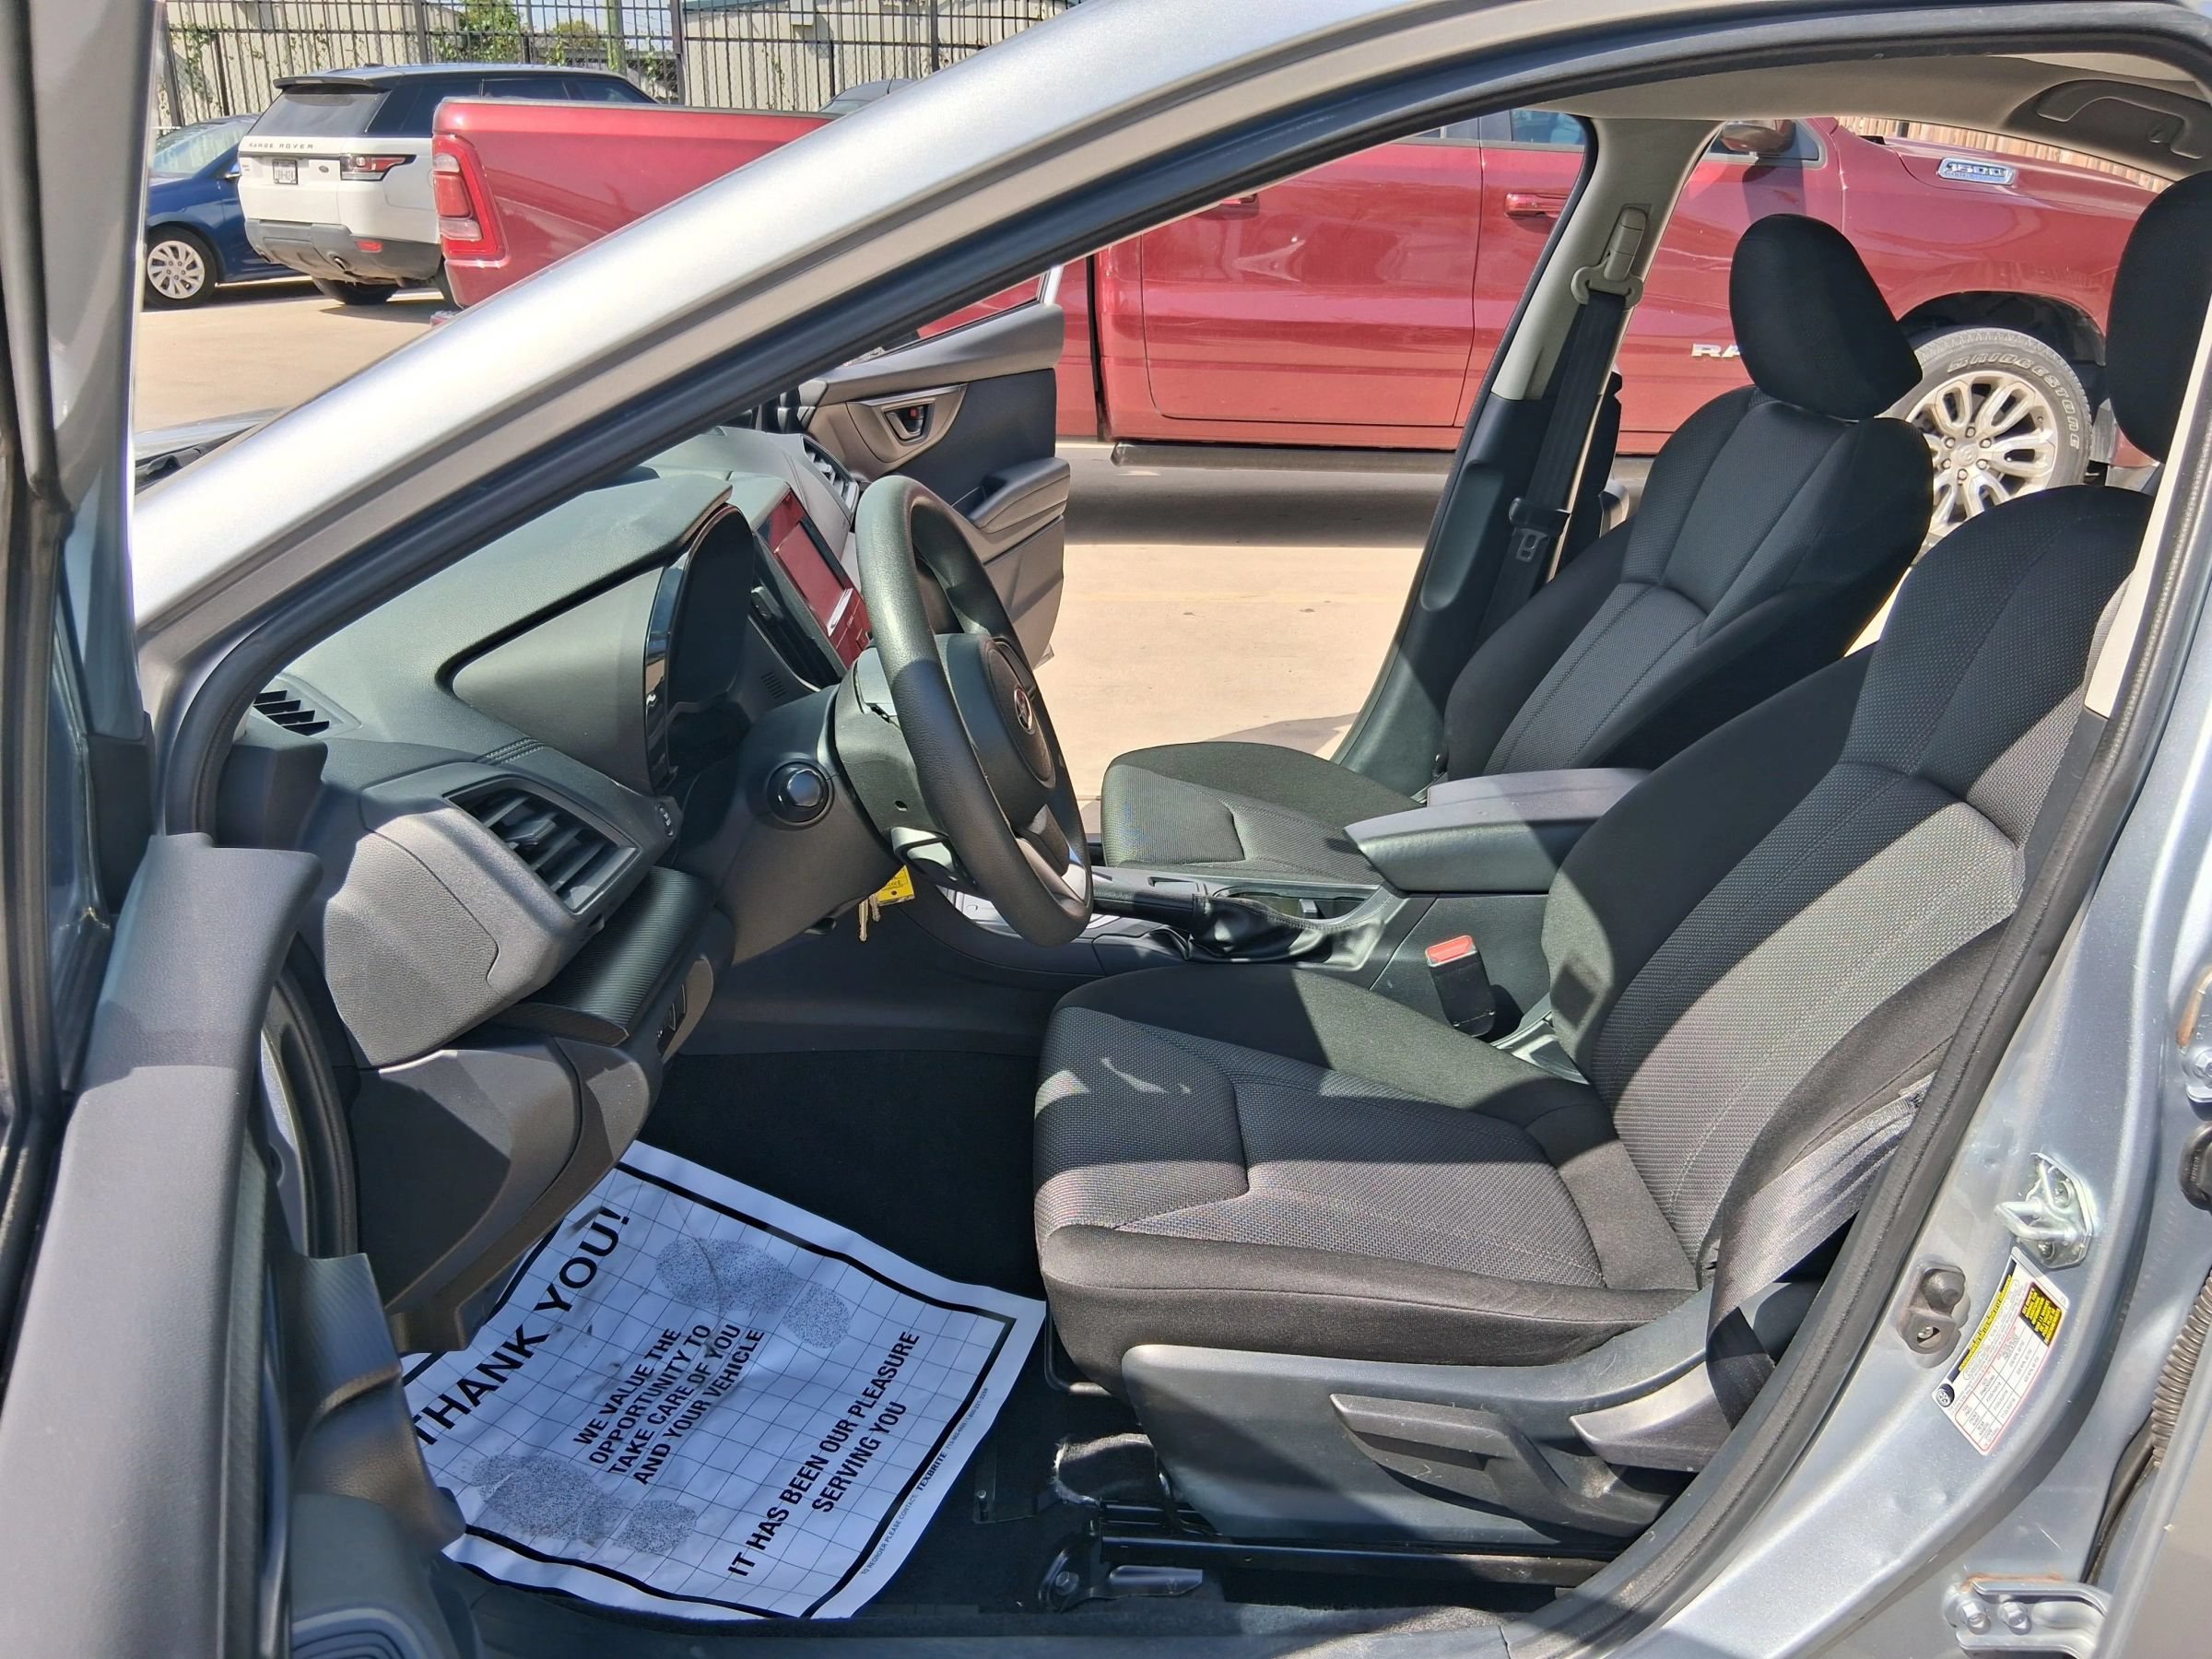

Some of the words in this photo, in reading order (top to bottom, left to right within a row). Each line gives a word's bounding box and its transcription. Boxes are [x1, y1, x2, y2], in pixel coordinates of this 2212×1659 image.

[1690, 343, 1741, 358] RA
[1947, 352, 2080, 450] BRIDGESTONE
[414, 1324, 550, 1445] THANK
[533, 1206, 629, 1312] YOU!
[573, 1418, 609, 1445] WE
[599, 1364, 654, 1417] VALUE
[643, 1328, 681, 1360] THE
[588, 1349, 691, 1465] OPPORTUNITY
[683, 1324, 711, 1347] TO
[606, 1429, 655, 1475] TAKE
[647, 1385, 694, 1425] CARE
[687, 1362, 712, 1385] OF
[704, 1324, 741, 1359] YOU
[633, 1442, 671, 1485] AND
[663, 1399, 712, 1439] YOUR
[702, 1329, 765, 1397] VEHICLE
[727, 1551, 756, 1576] IT
[746, 1506, 790, 1550] HAS
[779, 1454, 830, 1505] BEEN
[818, 1418, 858, 1453] OUR
[848, 1331, 920, 1419] PLEASURE
[811, 1436, 882, 1512] SERVING
[869, 1401, 907, 1434] YOU
[866, 1542, 888, 1571] REORDER
[886, 1518, 901, 1543] PLEASE
[916, 1451, 947, 1492] TEXBRITE
